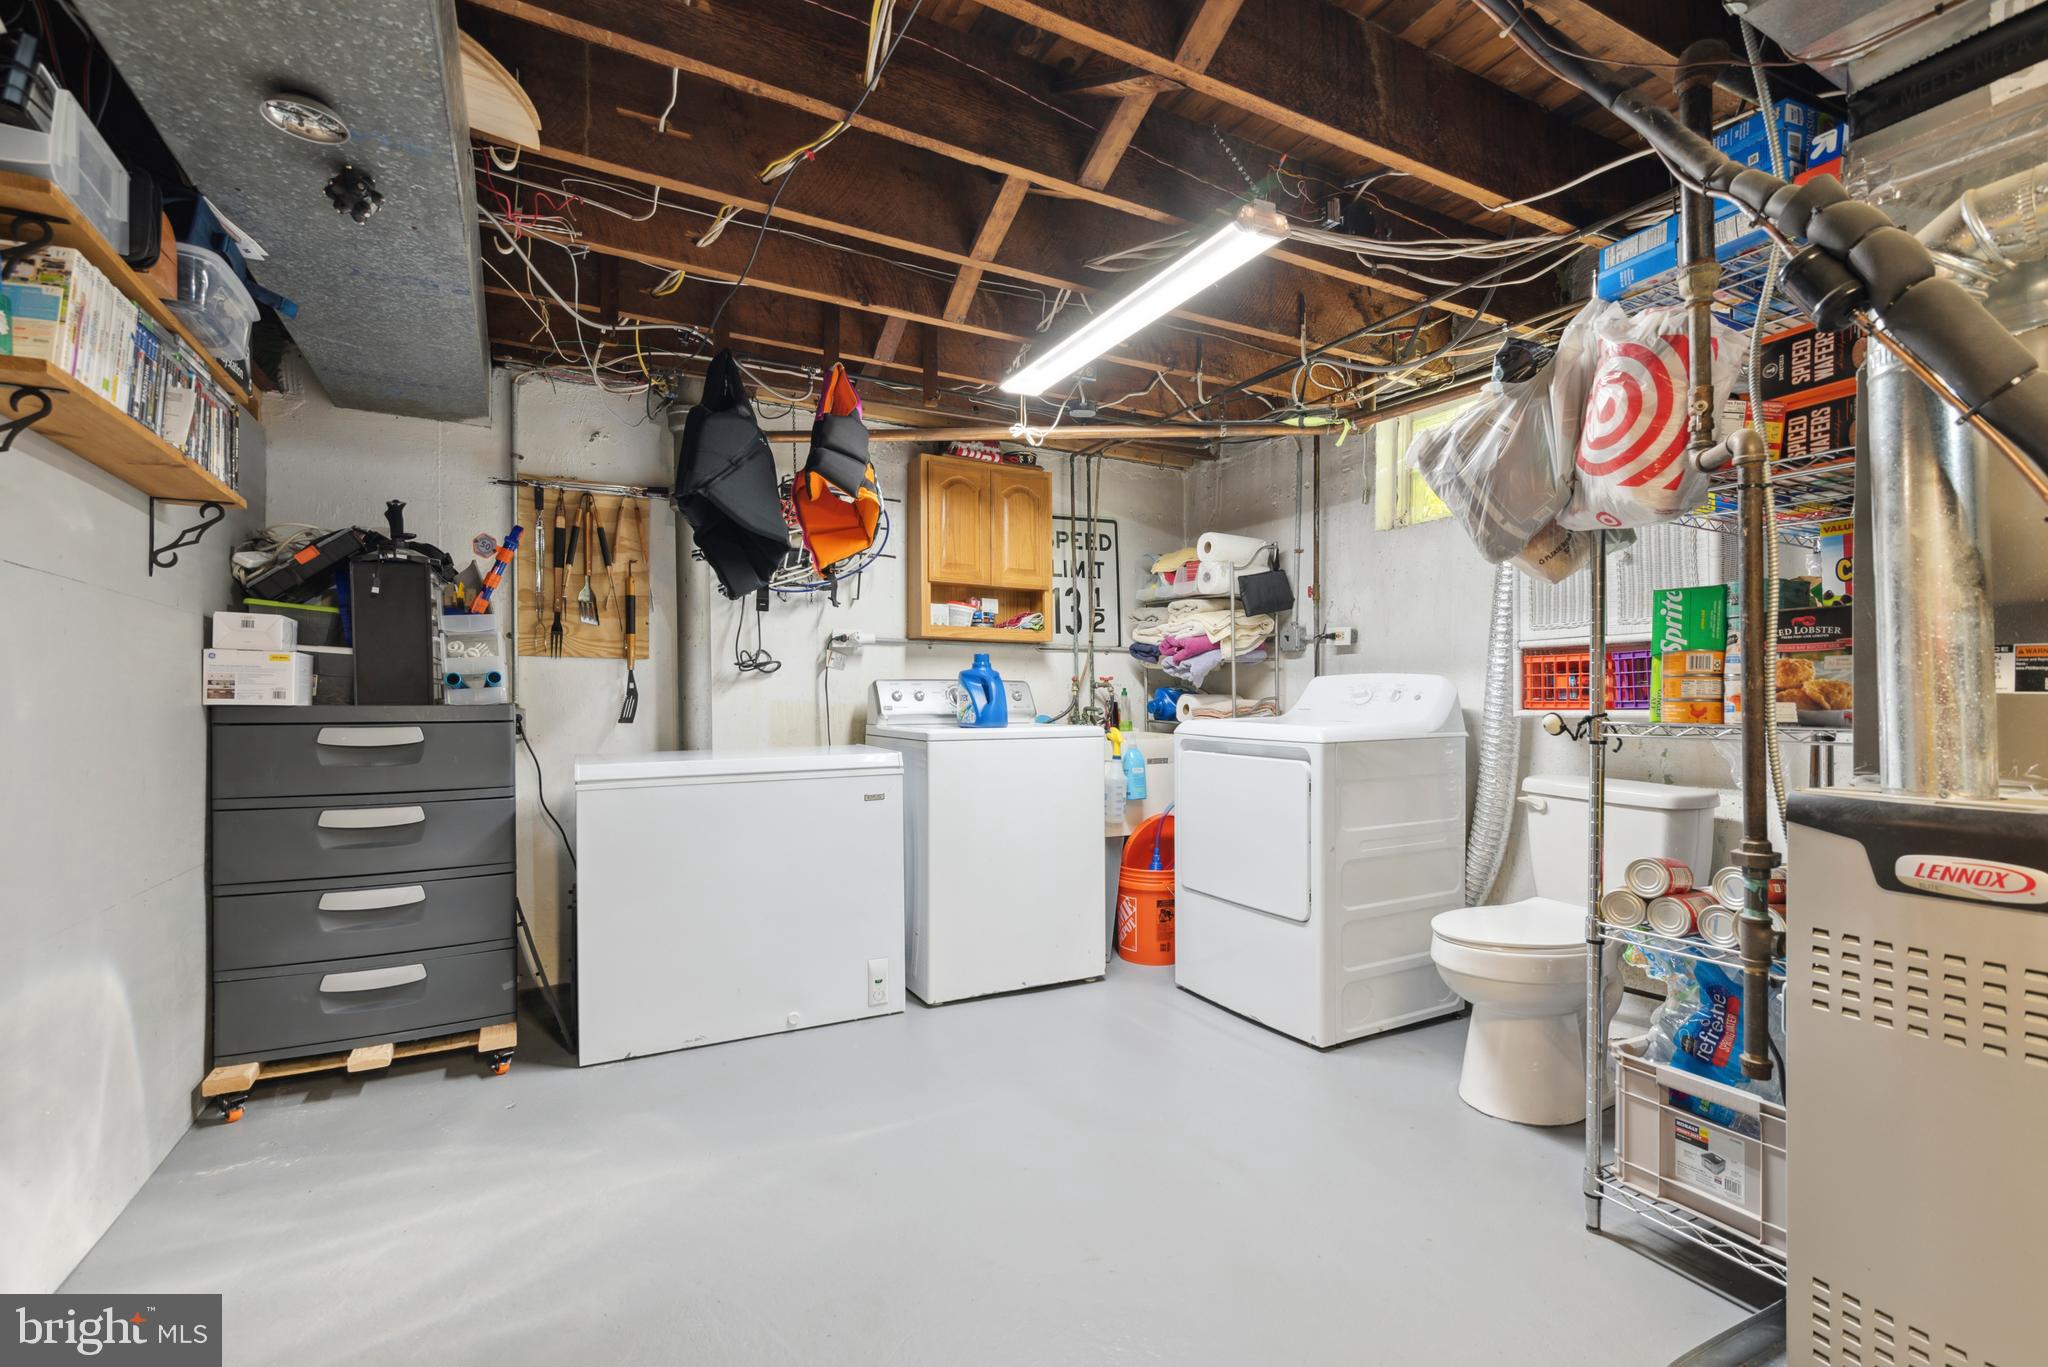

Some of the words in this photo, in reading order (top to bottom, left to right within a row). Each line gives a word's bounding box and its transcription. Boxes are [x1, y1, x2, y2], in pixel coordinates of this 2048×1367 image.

[1791, 338, 1812, 386] SPICED
[1813, 332, 1834, 382] WAFERS
[1052, 531, 1112, 552] PEED
[1052, 560, 1105, 579] LIMT
[1660, 590, 1688, 651] Sprite
[1794, 626, 1842, 635] LOBSTER
[1914, 862, 2010, 889] LENNOX
